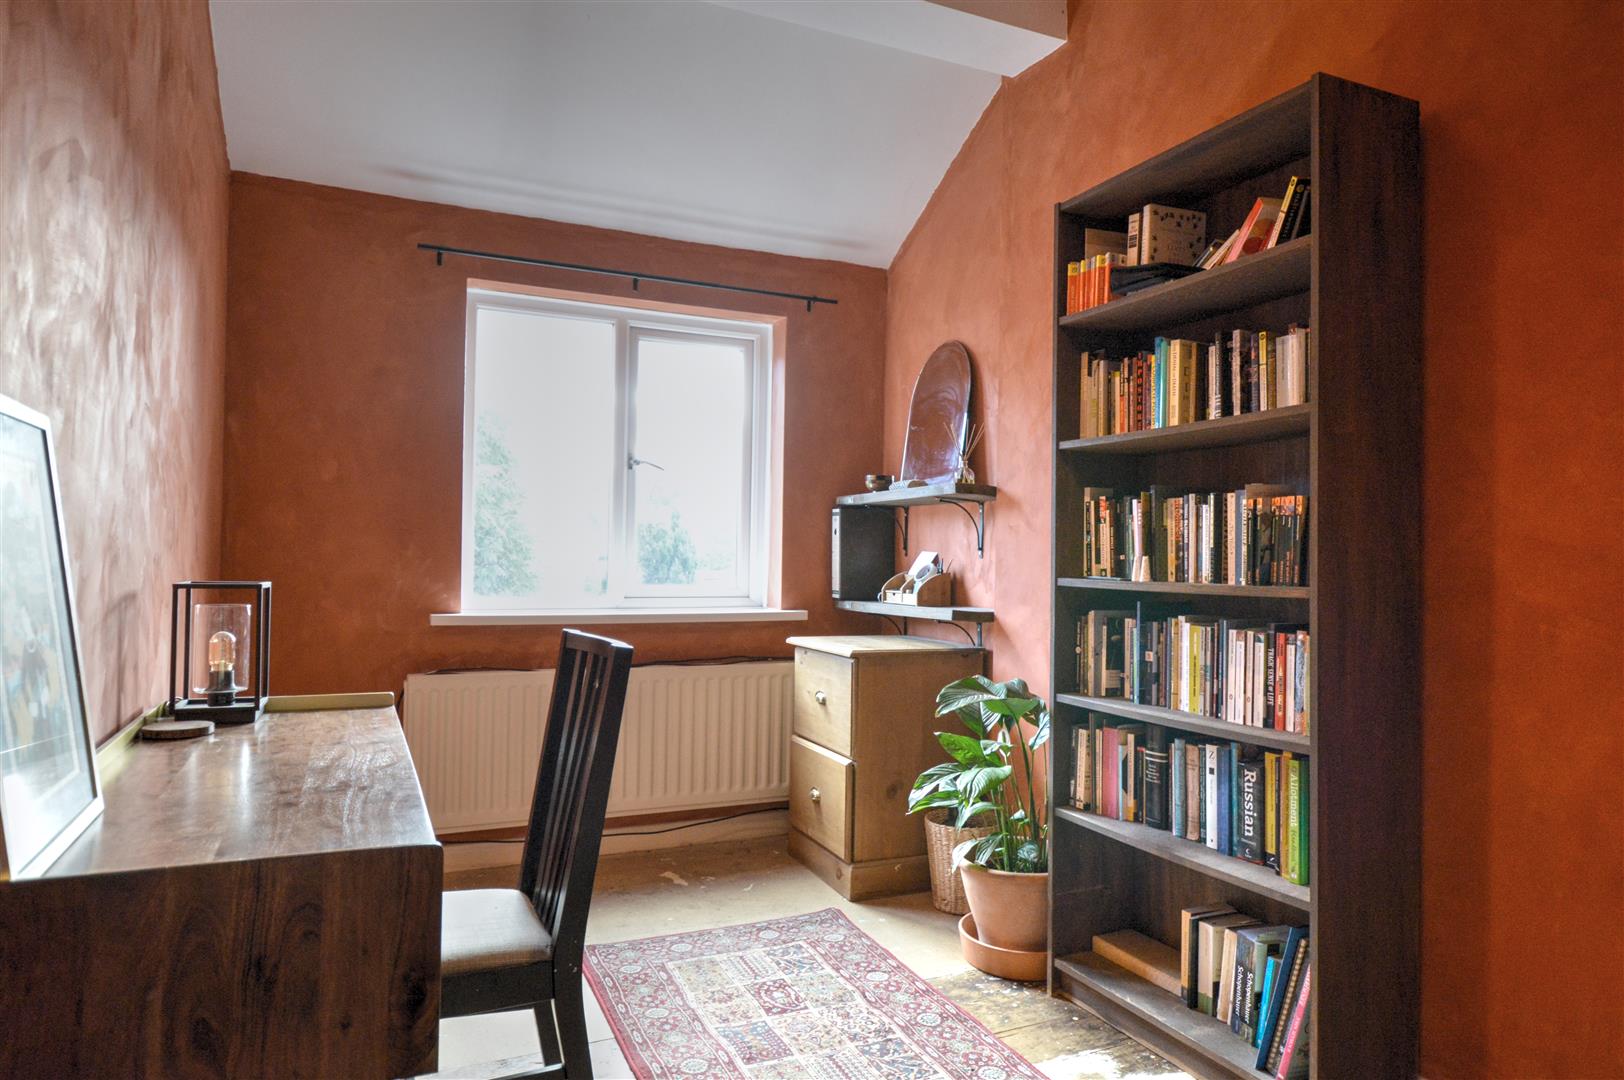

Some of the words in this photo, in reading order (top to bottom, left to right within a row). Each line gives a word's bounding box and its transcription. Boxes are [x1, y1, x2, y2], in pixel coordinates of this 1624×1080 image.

[1267, 692, 1275, 706] LIFE
[1244, 768, 1257, 837] Russian
[1290, 773, 1298, 827] Allotment
[1234, 965, 1244, 1017] Schopenhauer
[1244, 971, 1254, 1024] Schopenhauer
